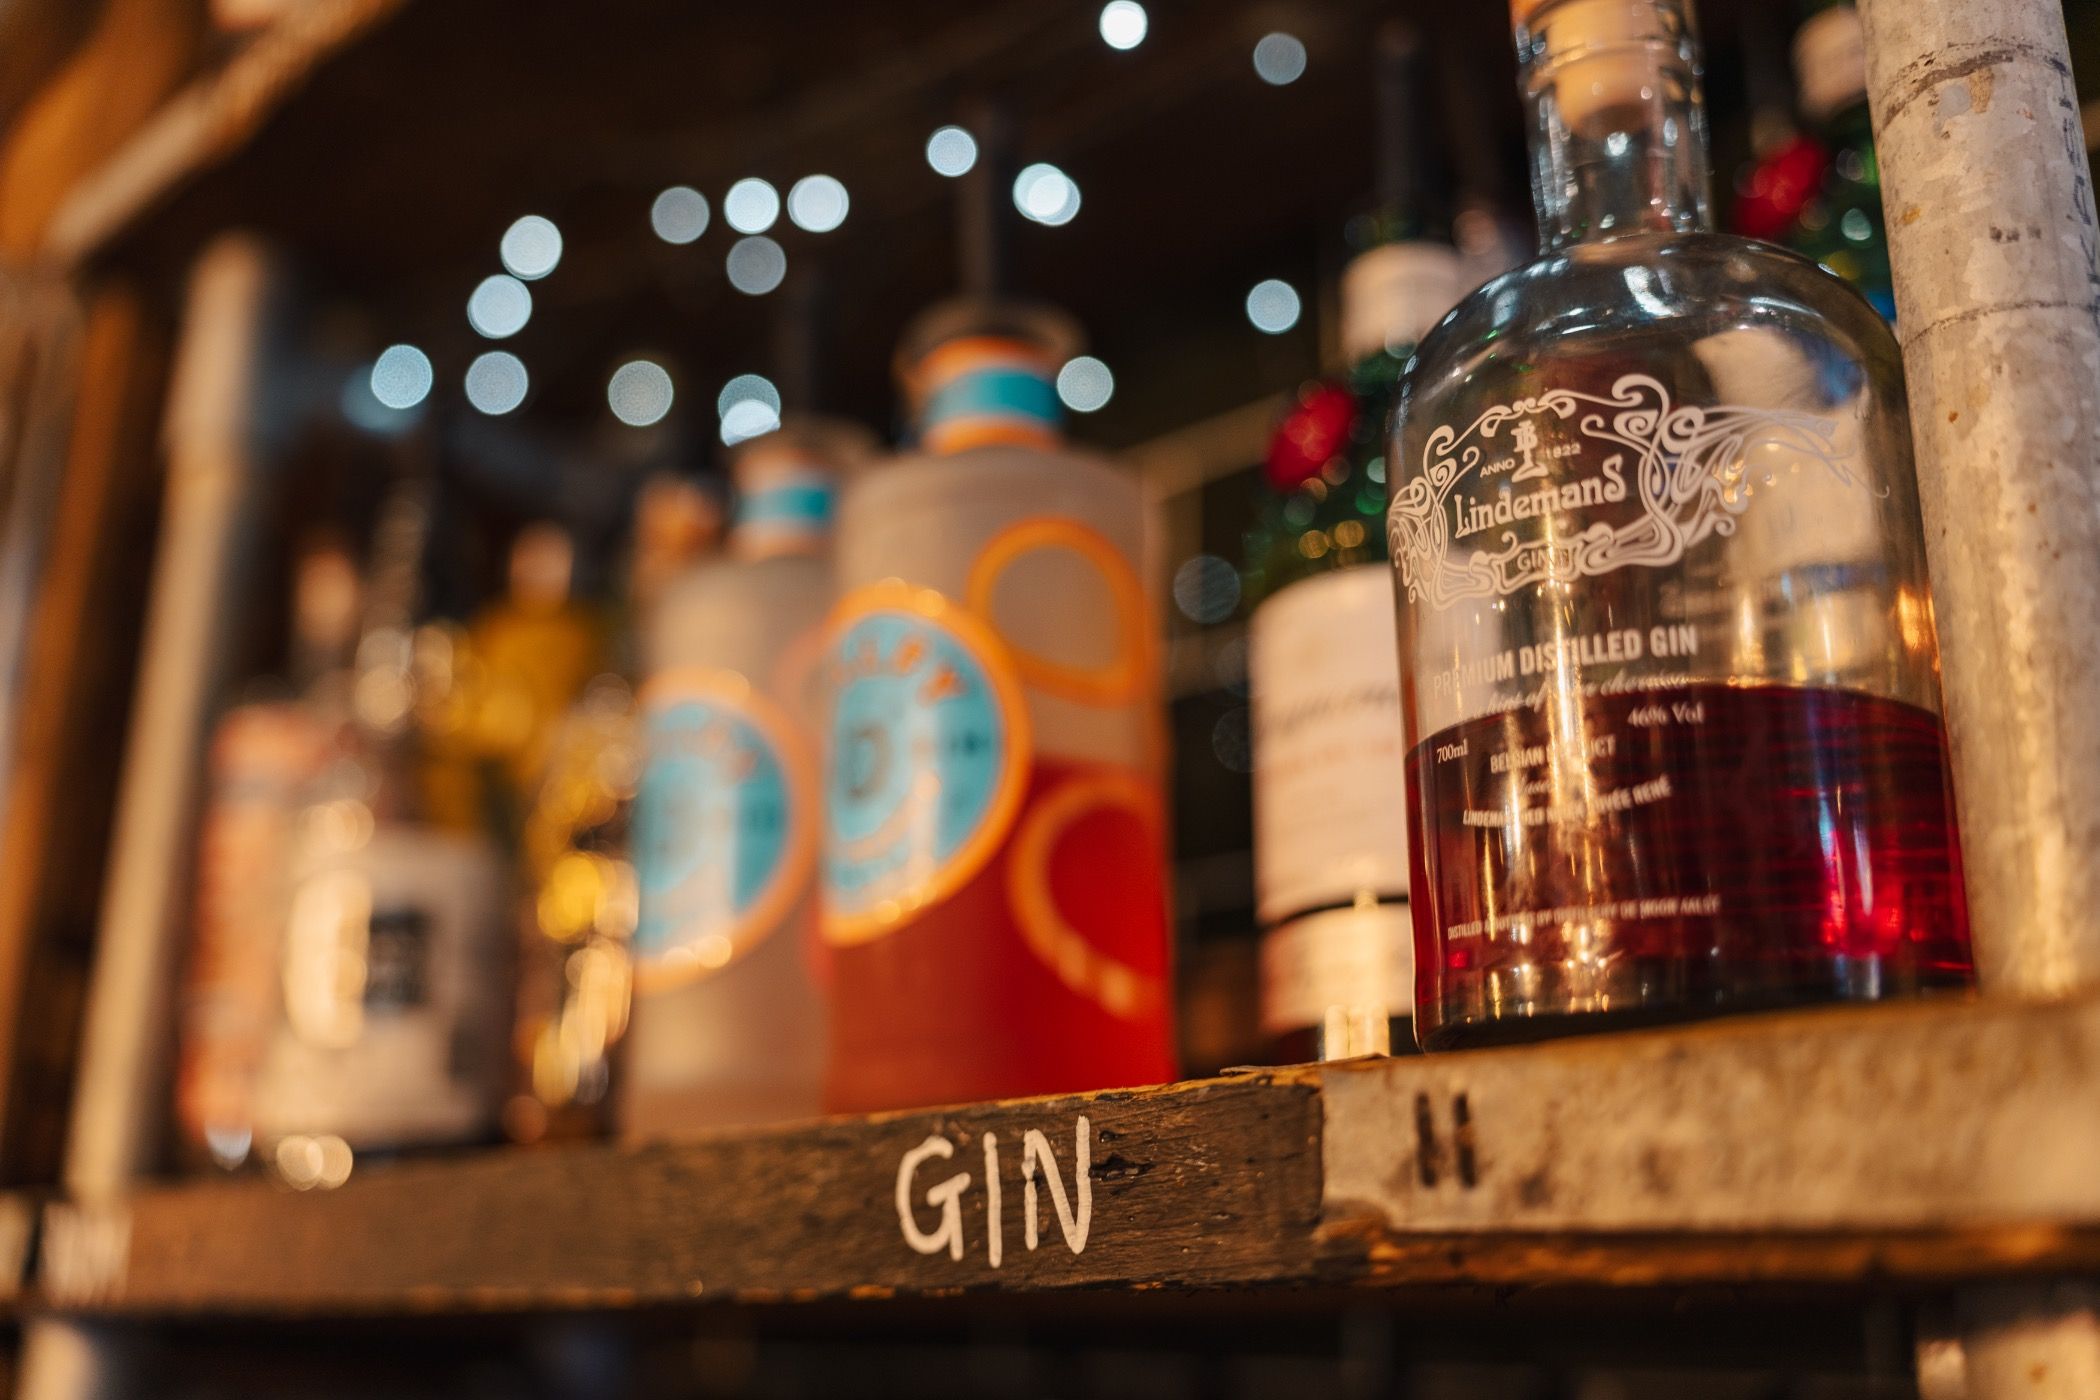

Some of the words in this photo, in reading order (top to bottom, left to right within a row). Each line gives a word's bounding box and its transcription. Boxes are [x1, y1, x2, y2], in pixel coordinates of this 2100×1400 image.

[1480, 457, 1516, 478] ANNO
[1546, 441, 1581, 460] 1822
[1433, 650, 1515, 699] PREMIUM
[1519, 627, 1643, 676] DISTILLED
[1650, 623, 1699, 658] GIN
[1627, 704, 1669, 728] 46%
[1671, 700, 1705, 724] Vol
[1436, 738, 1469, 763] 700ml
[895, 1114, 1093, 1269] GIN
